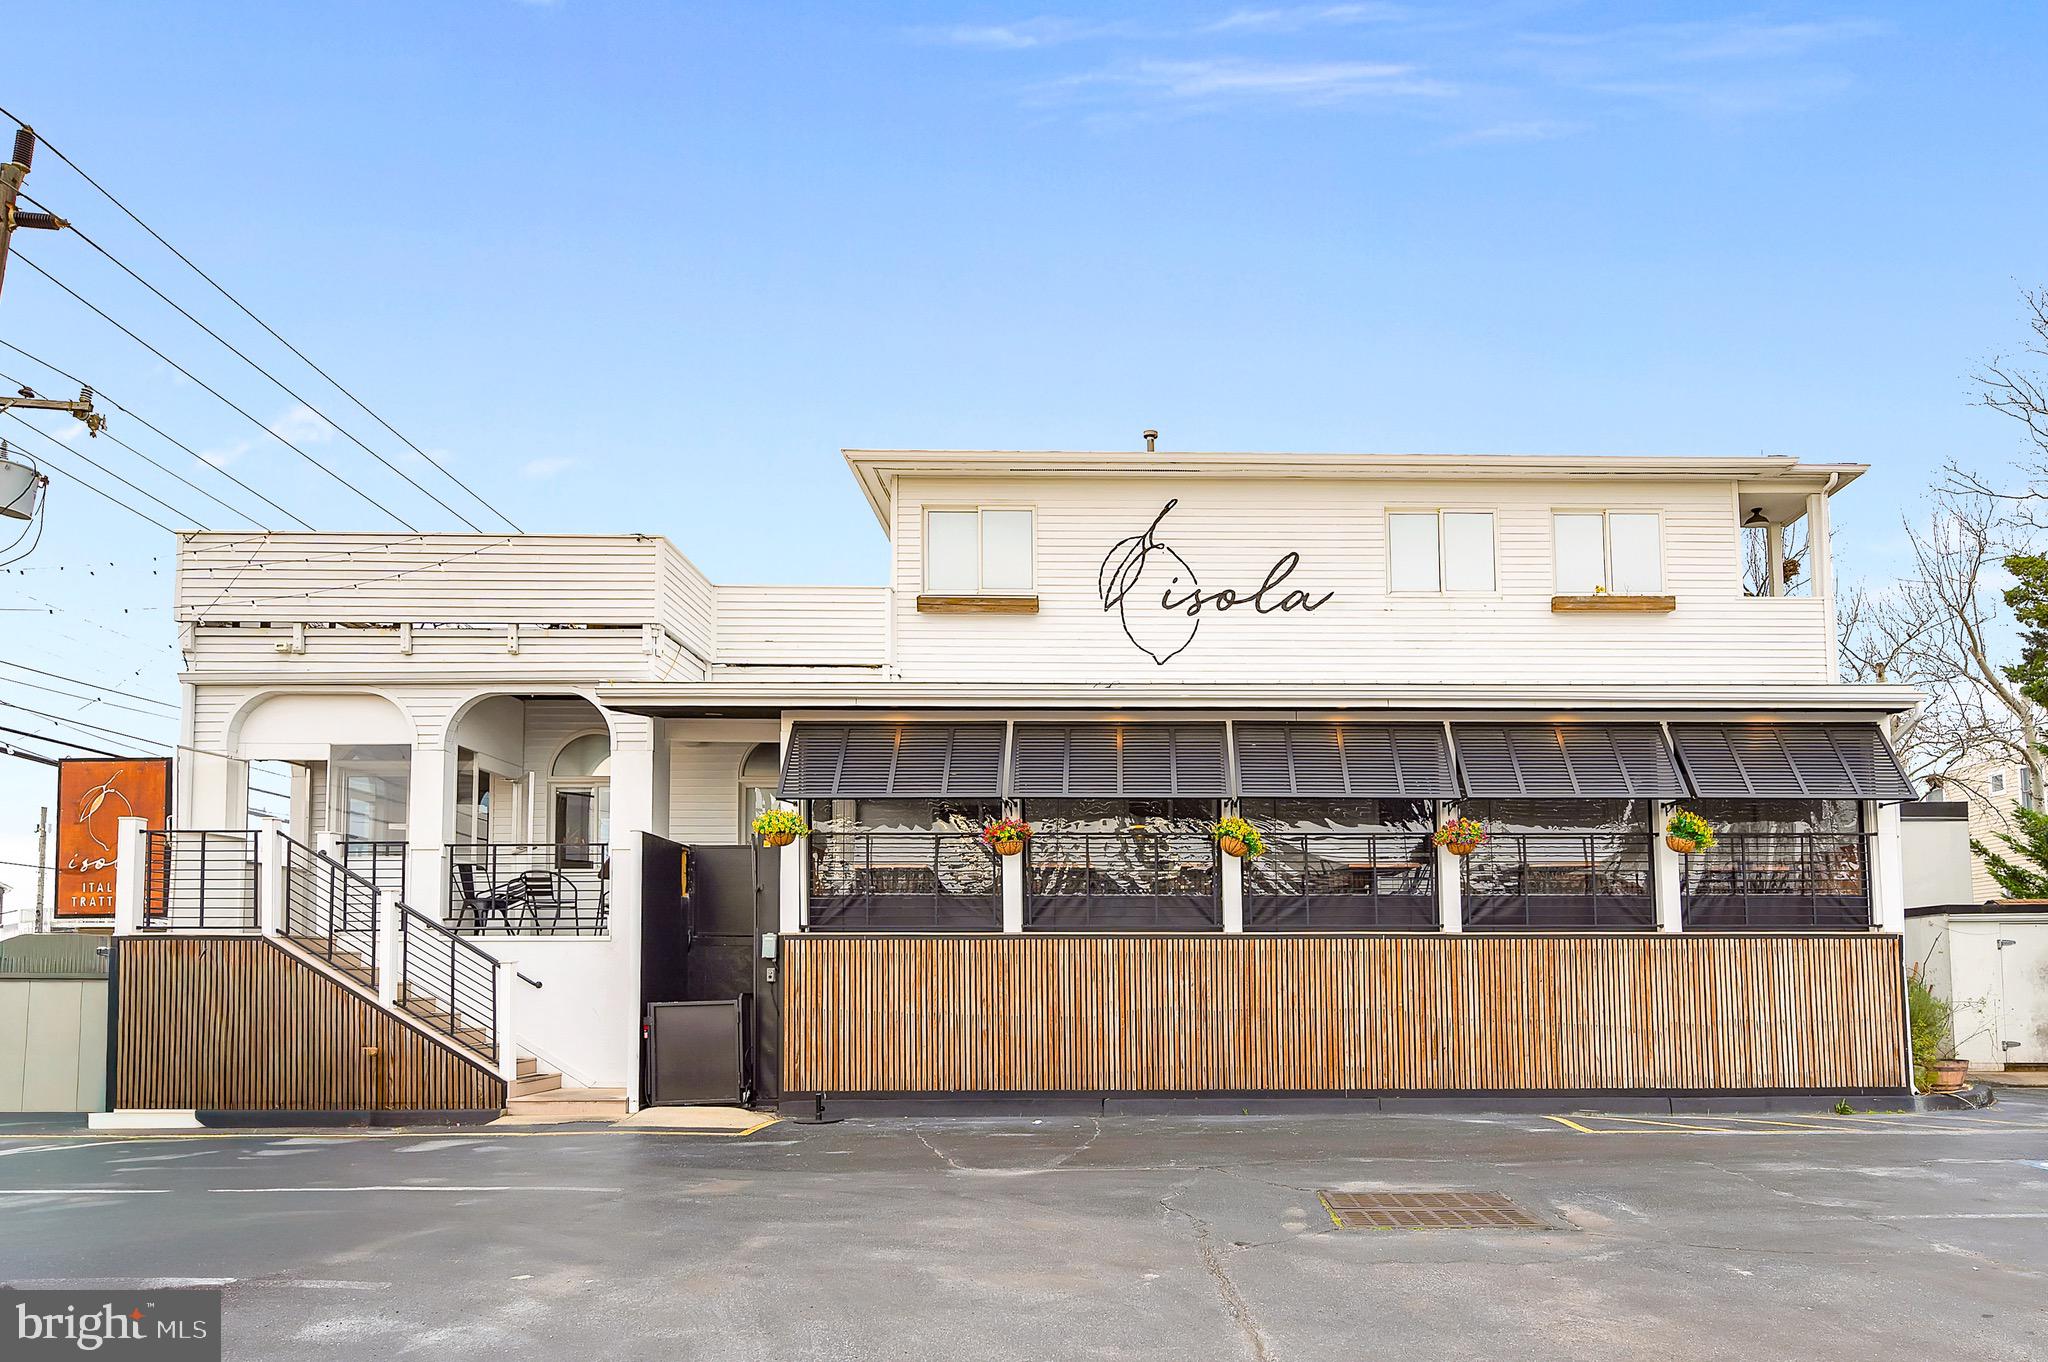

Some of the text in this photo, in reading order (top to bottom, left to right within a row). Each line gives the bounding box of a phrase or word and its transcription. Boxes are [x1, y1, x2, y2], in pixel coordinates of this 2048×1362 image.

[1162, 551, 1334, 616] isola
[68, 853, 118, 872] iso
[82, 882, 113, 893] ITAL
[71, 896, 113, 907] TRATT
